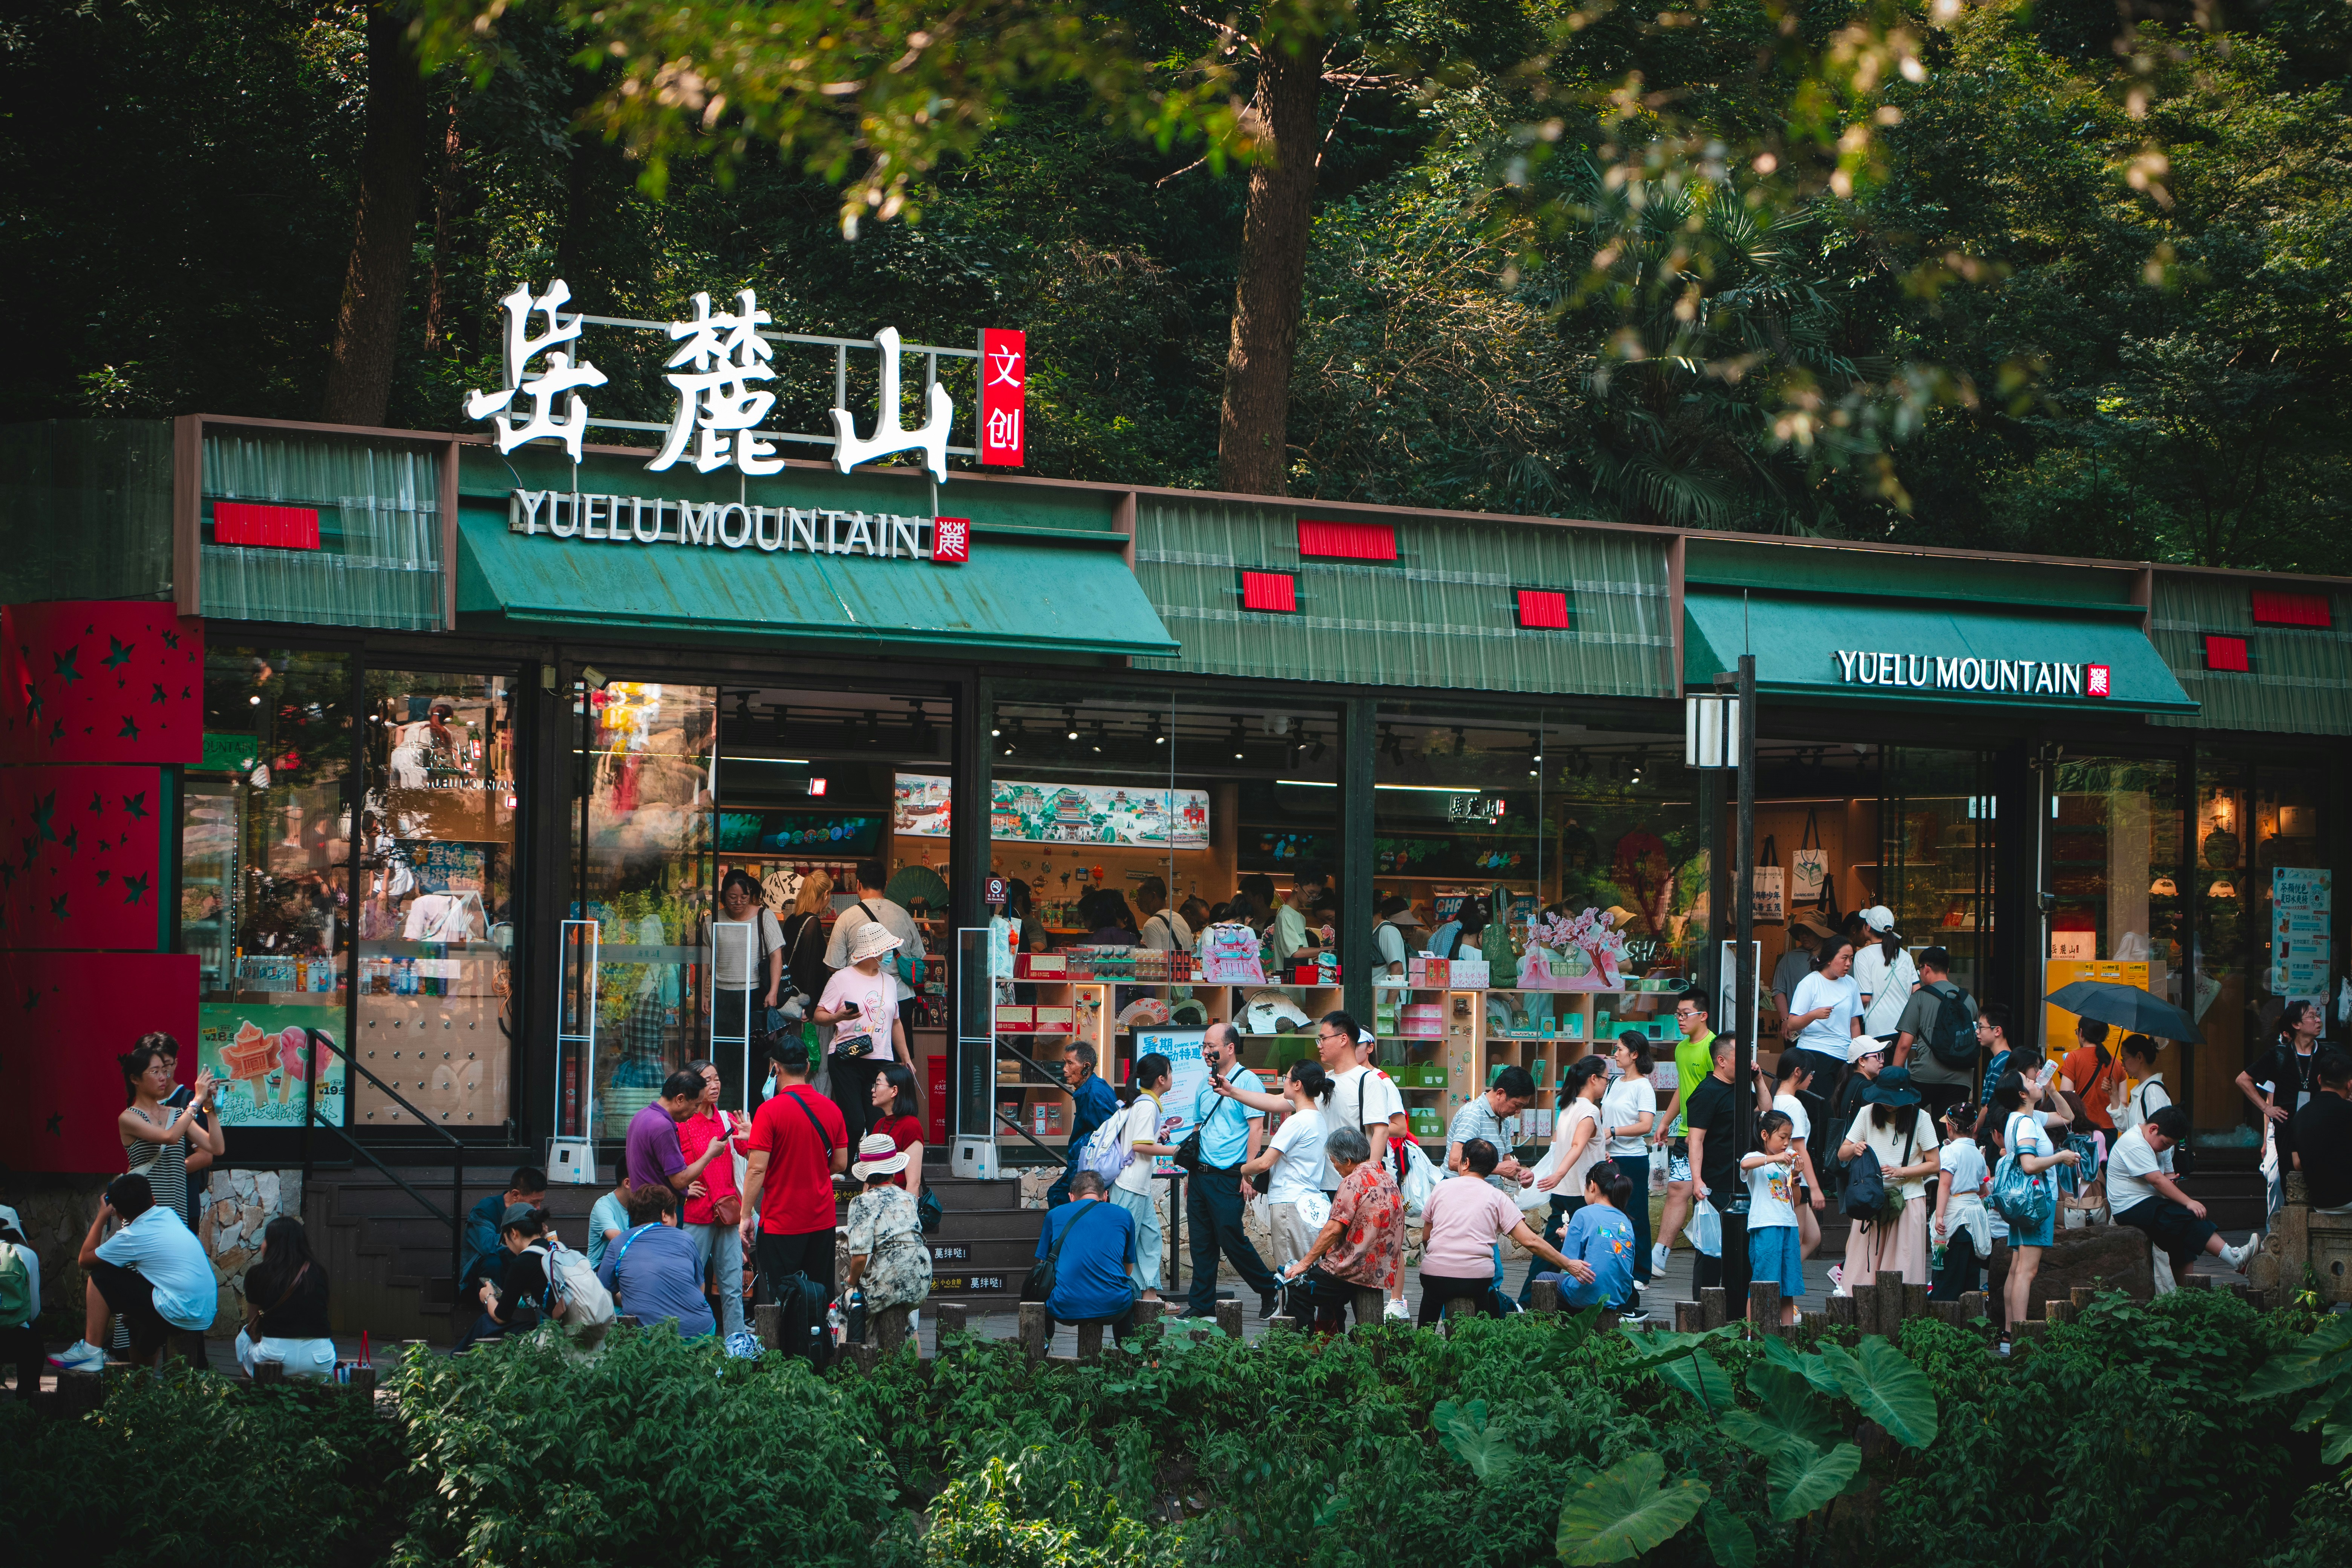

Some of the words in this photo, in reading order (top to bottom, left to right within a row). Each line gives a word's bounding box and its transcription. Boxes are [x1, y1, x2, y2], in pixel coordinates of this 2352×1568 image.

[462, 279, 953, 484] 岳麓山
[986, 345, 1021, 451] 文创
[514, 488, 662, 543] YUELU
[677, 499, 920, 560] MOUNTAIN
[1838, 651, 1928, 686] YUELU
[1936, 657, 2080, 694] MOUNTAIN
[430, 845, 462, 867] 星城
[2051, 943, 2075, 954] 岳麓山
[1142, 1035, 1173, 1054] 暑期
[1159, 1047, 1202, 1062] 动特惠
[1307, 1198, 1320, 1222] 長沙
[935, 1247, 966, 1259] 莫绊哒!
[971, 1277, 1002, 1288] 莫绊哒!
